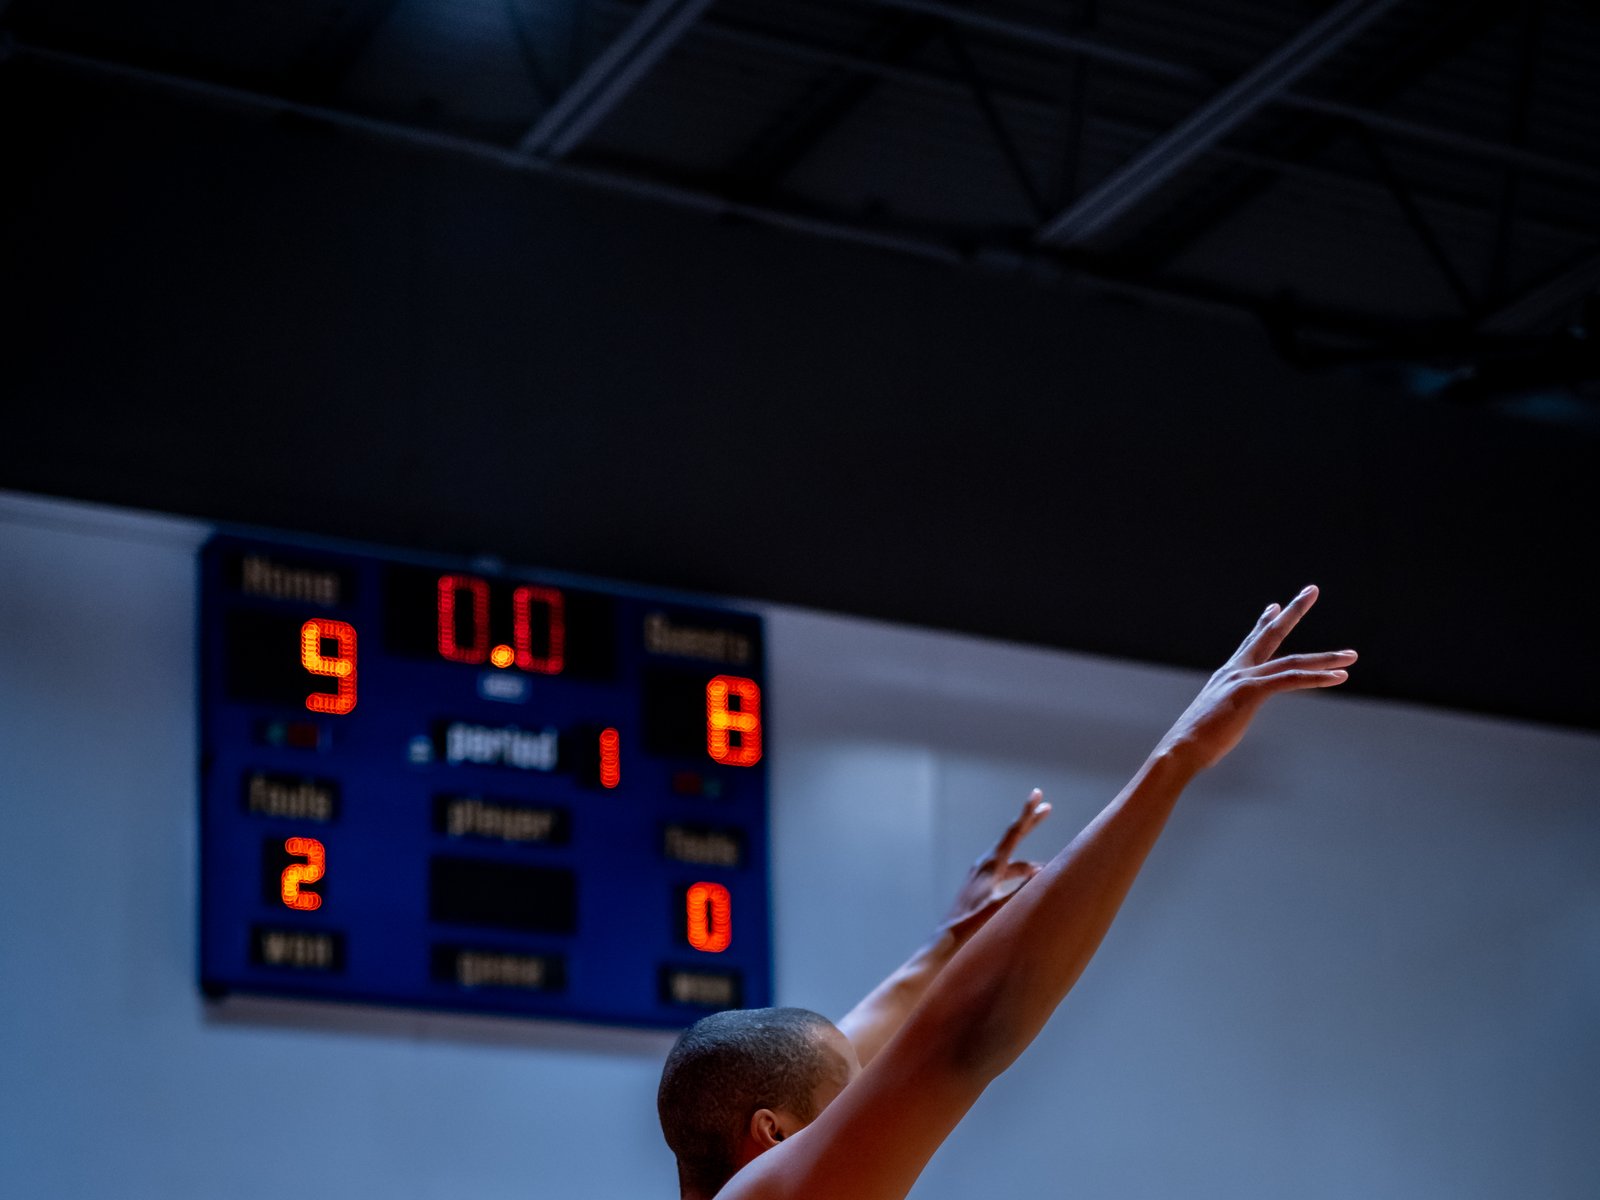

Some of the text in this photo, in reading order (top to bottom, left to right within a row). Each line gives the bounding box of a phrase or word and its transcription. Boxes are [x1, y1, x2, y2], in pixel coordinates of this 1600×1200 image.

[437, 574, 566, 675] 0.0
[301, 618, 357, 715] 9
[599, 728, 621, 788] 1
[706, 675, 763, 767] 8
[281, 837, 325, 910] 2
[687, 882, 732, 952] 0
